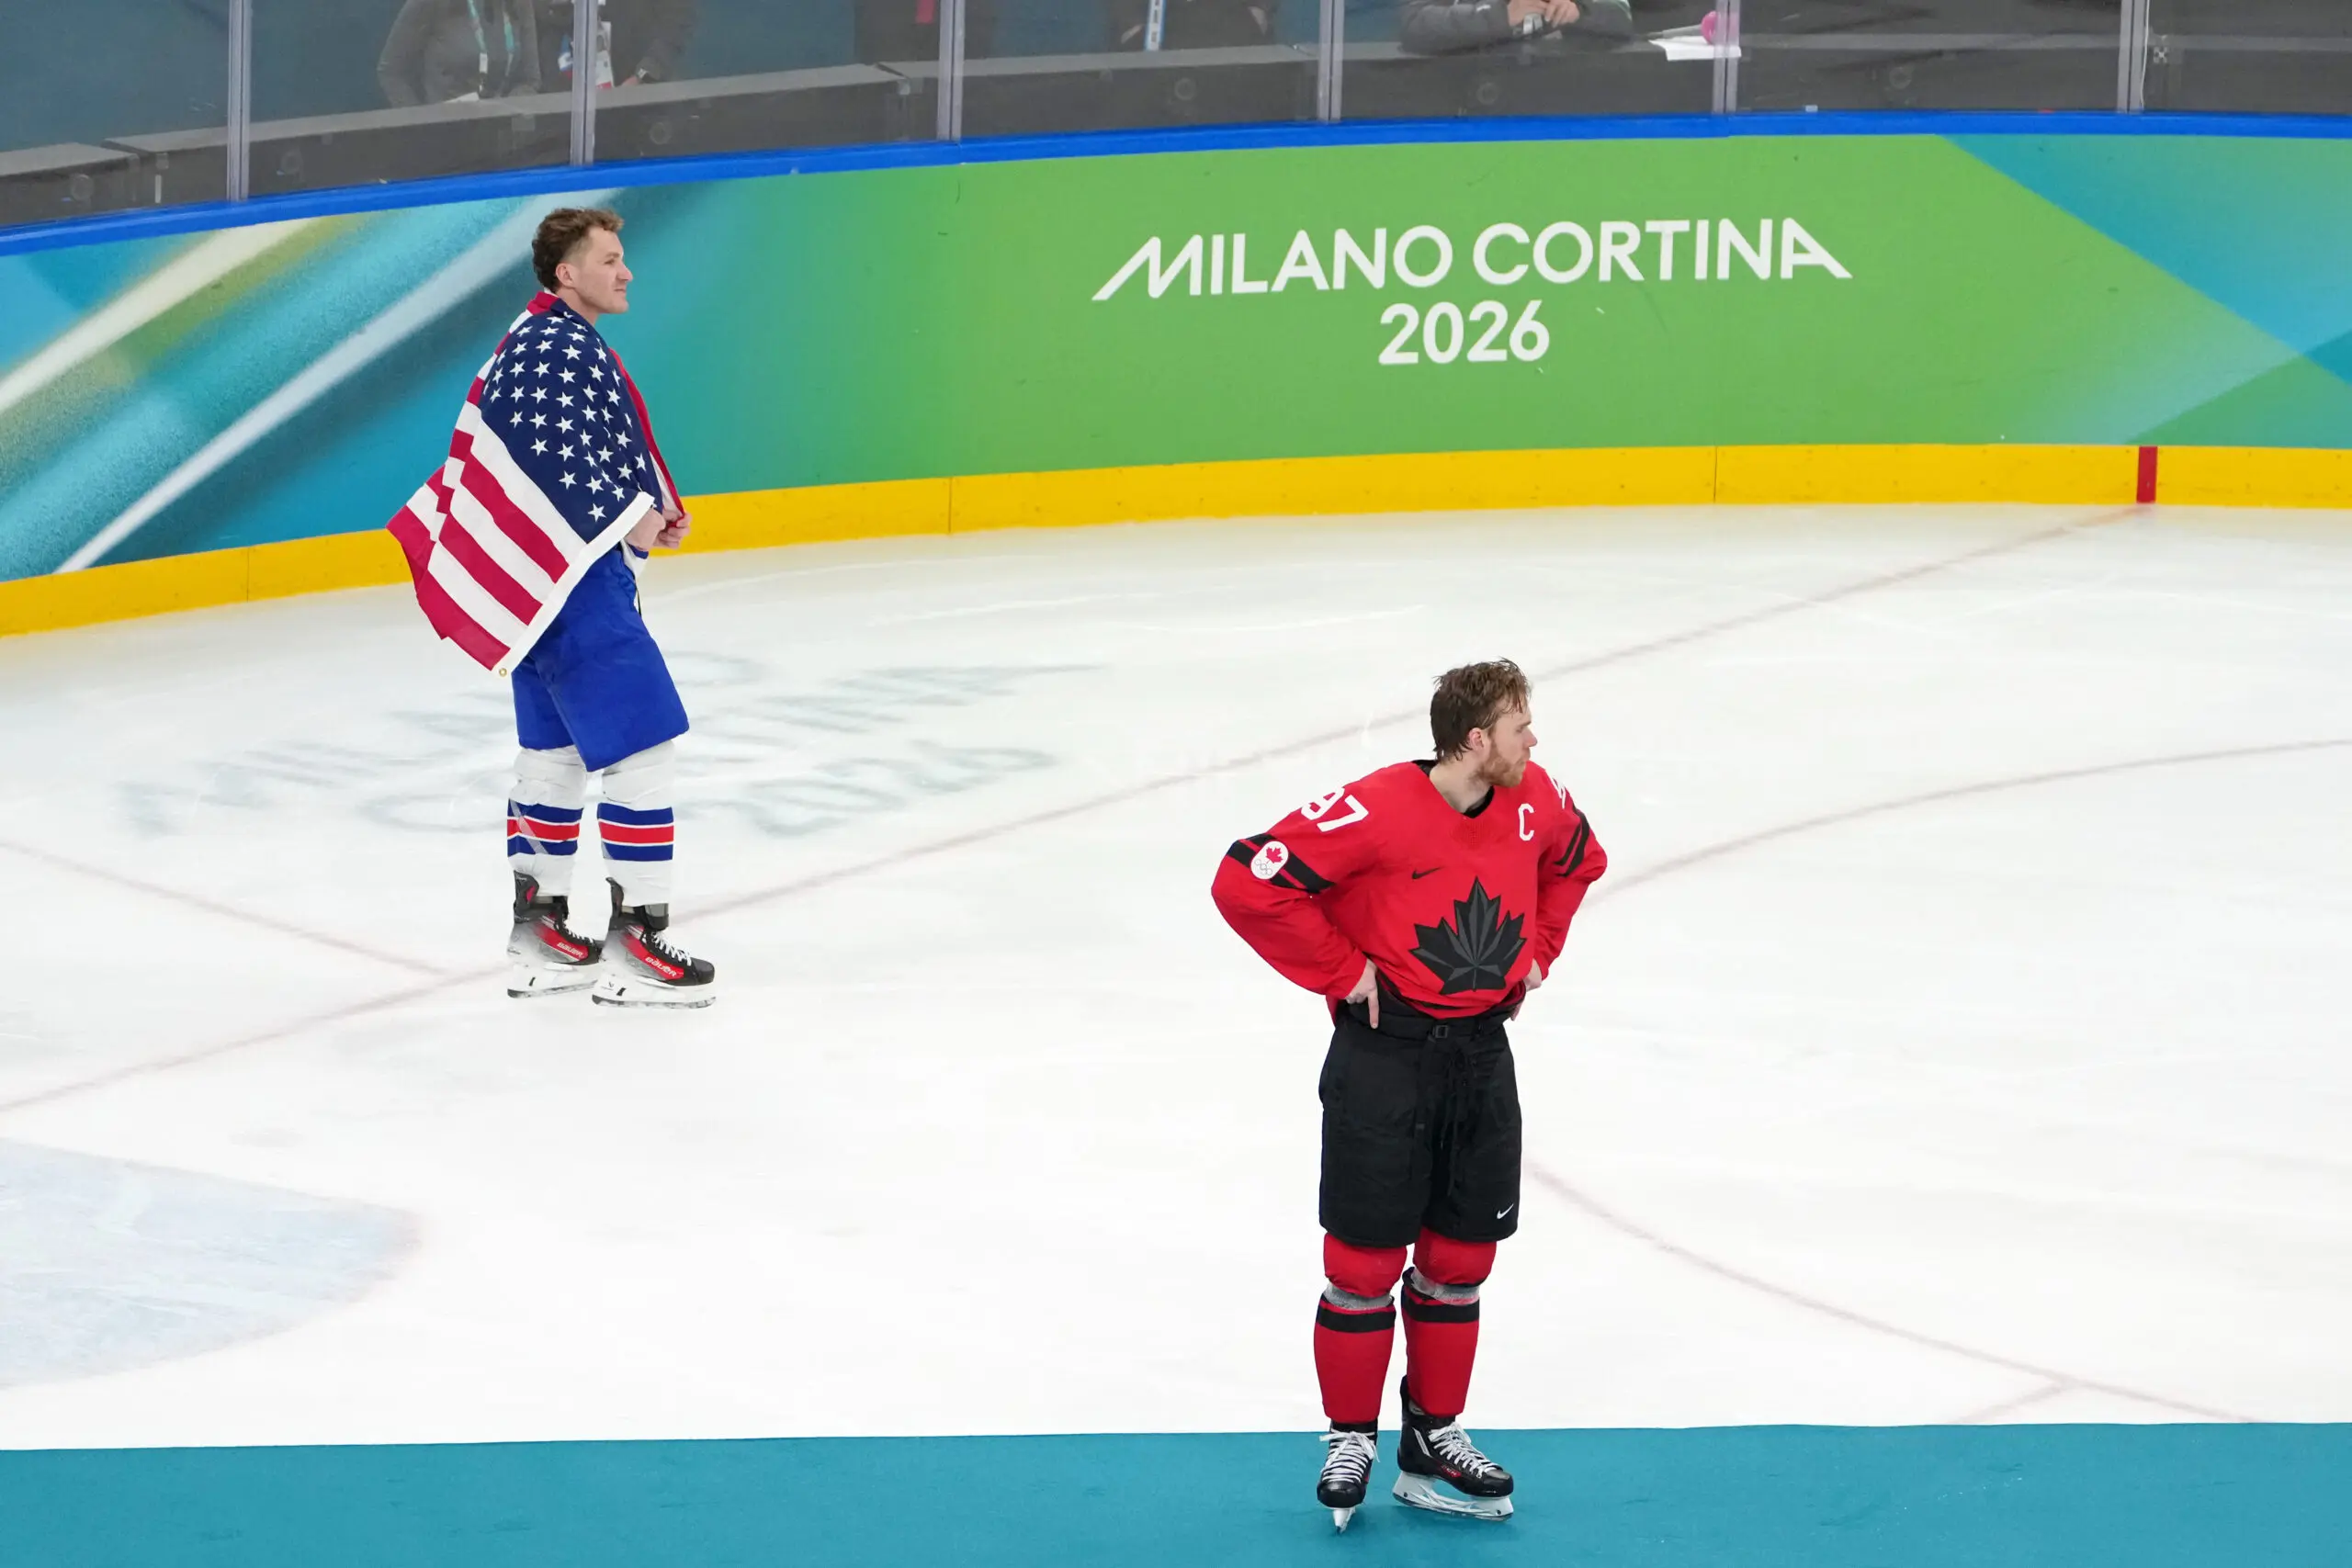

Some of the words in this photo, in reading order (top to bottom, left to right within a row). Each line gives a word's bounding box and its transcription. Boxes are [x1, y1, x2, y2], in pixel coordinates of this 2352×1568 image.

[1092, 226, 1453, 300] MILANO
[1474, 219, 1851, 285] CORTINA
[1379, 301, 1549, 364] 2026
[114, 649, 770, 840] MILAO
[1301, 785, 1369, 832] 97
[1518, 803, 1534, 841] C
